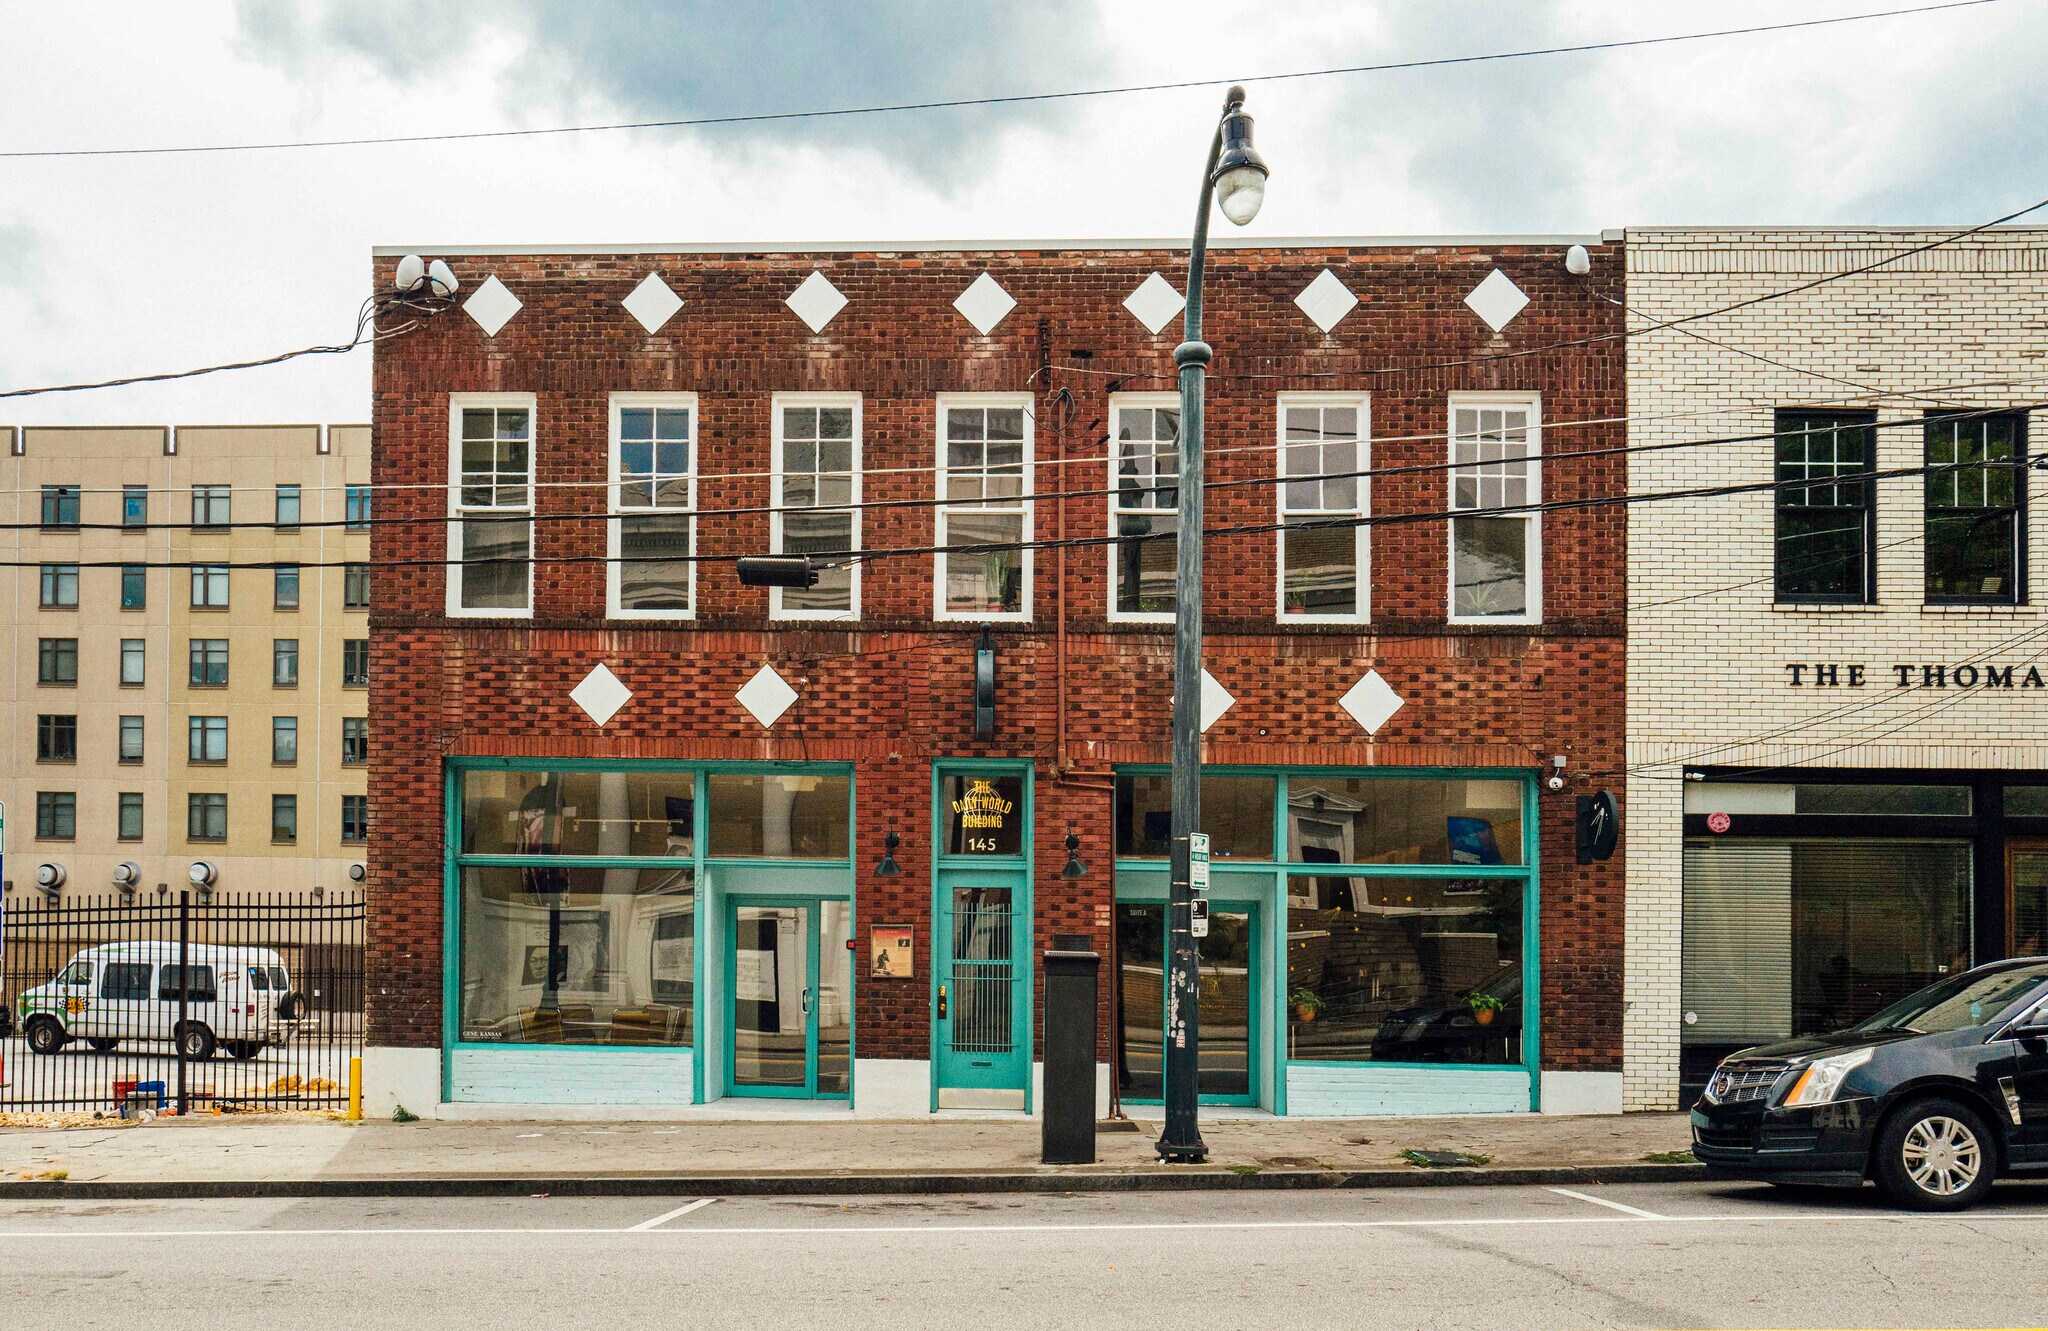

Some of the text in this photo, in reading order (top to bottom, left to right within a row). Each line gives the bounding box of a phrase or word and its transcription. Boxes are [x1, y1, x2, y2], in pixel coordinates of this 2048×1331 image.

[1786, 664, 2046, 688] THE THOMA
[974, 780, 990, 793] THE
[952, 796, 1013, 814] DAILY WORLD
[962, 815, 1003, 828] BUILDING
[968, 837, 996, 851] 145
